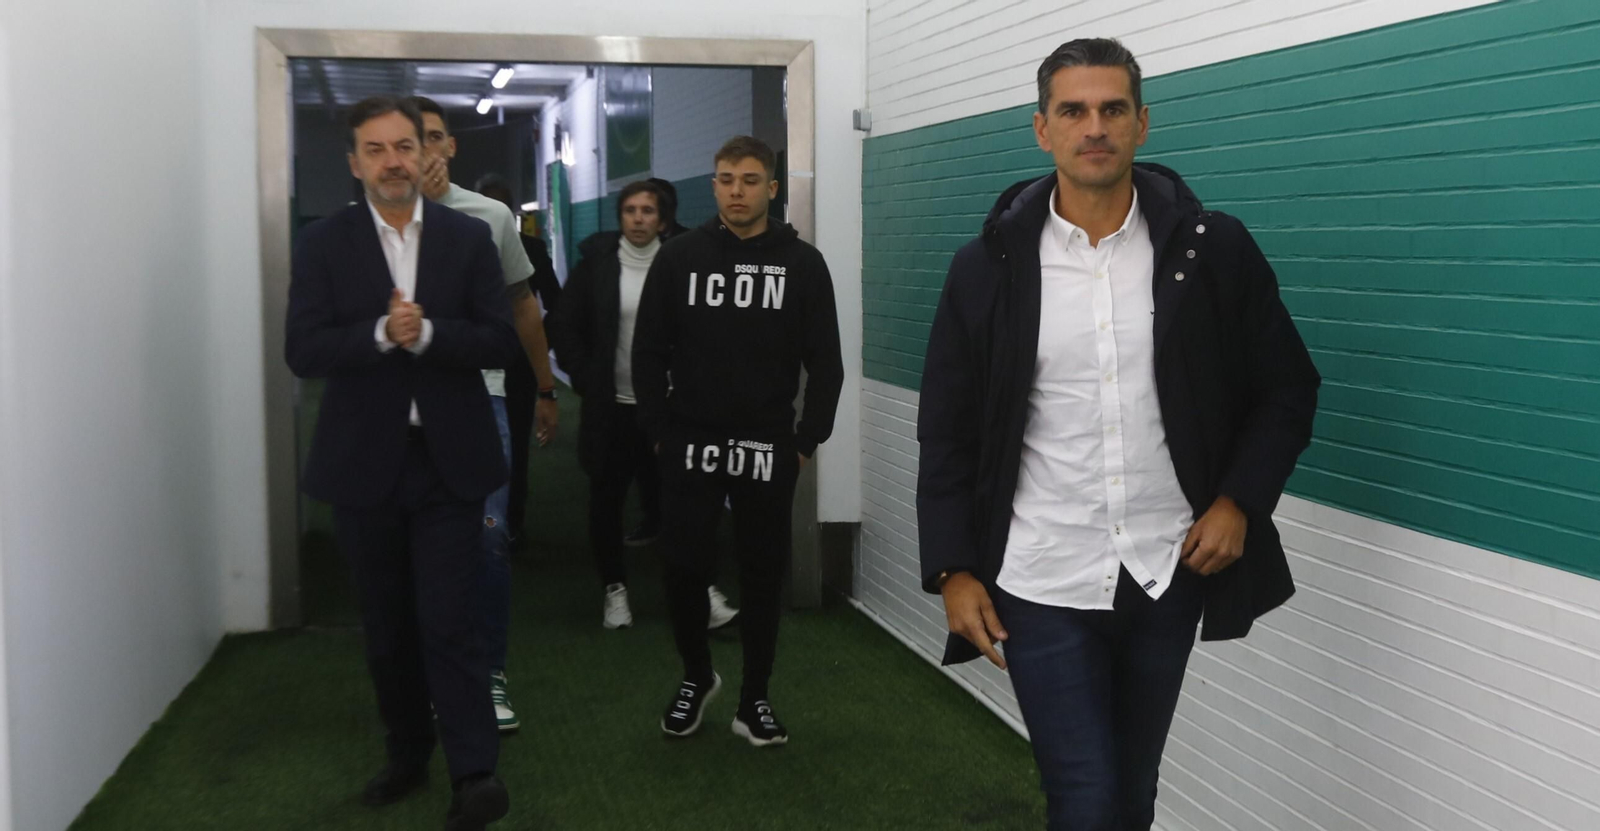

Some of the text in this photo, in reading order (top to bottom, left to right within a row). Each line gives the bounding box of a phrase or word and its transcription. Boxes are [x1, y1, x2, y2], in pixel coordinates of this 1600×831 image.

[734, 264, 786, 275] DSQURED2
[688, 272, 785, 309] ICON
[685, 444, 773, 481] ICON
[728, 438, 773, 451] DQUARED2
[670, 680, 697, 719] ICON
